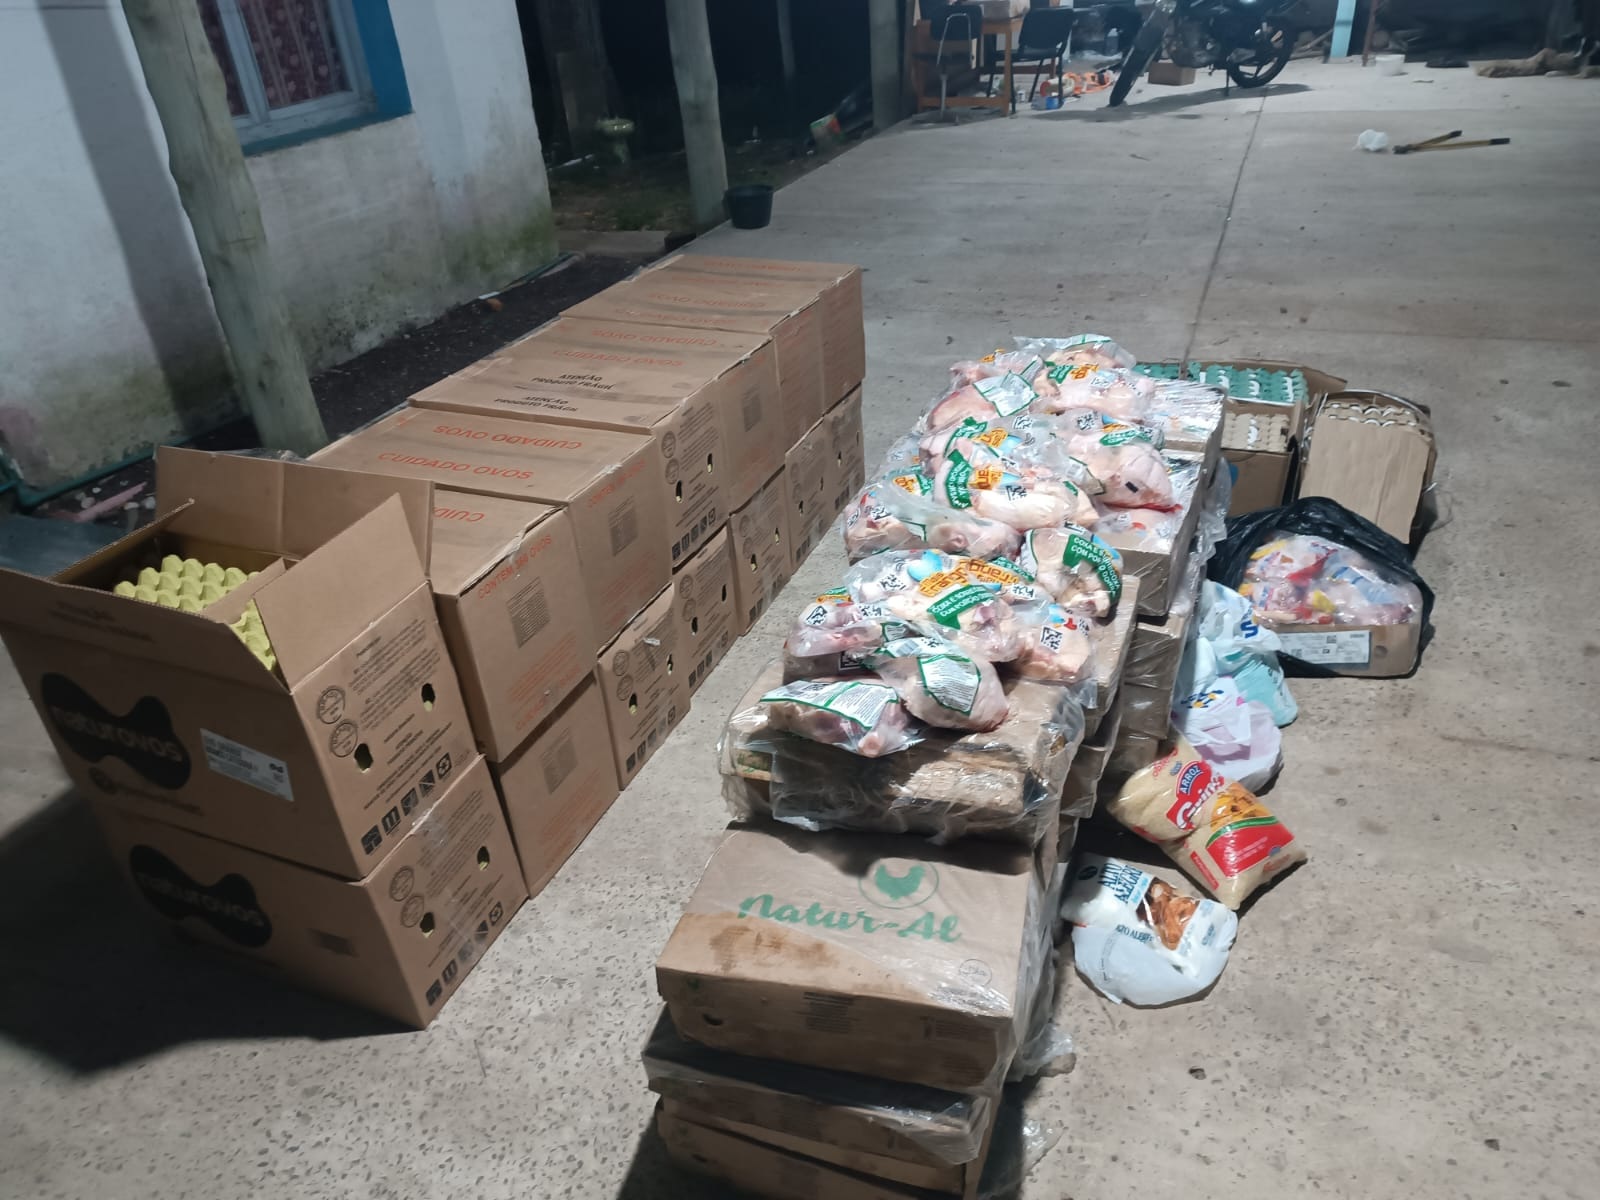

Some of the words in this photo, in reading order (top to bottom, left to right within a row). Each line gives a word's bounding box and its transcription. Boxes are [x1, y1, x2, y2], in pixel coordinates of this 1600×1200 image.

[433, 424, 489, 441] OVOS
[491, 432, 583, 450] CUIDADO
[378, 452, 471, 472] CUIDADO
[473, 465, 534, 480] OVOS
[433, 507, 485, 522] CUID
[1180, 765, 1202, 794] ARROZ
[1114, 865, 1144, 904] ALEGR
